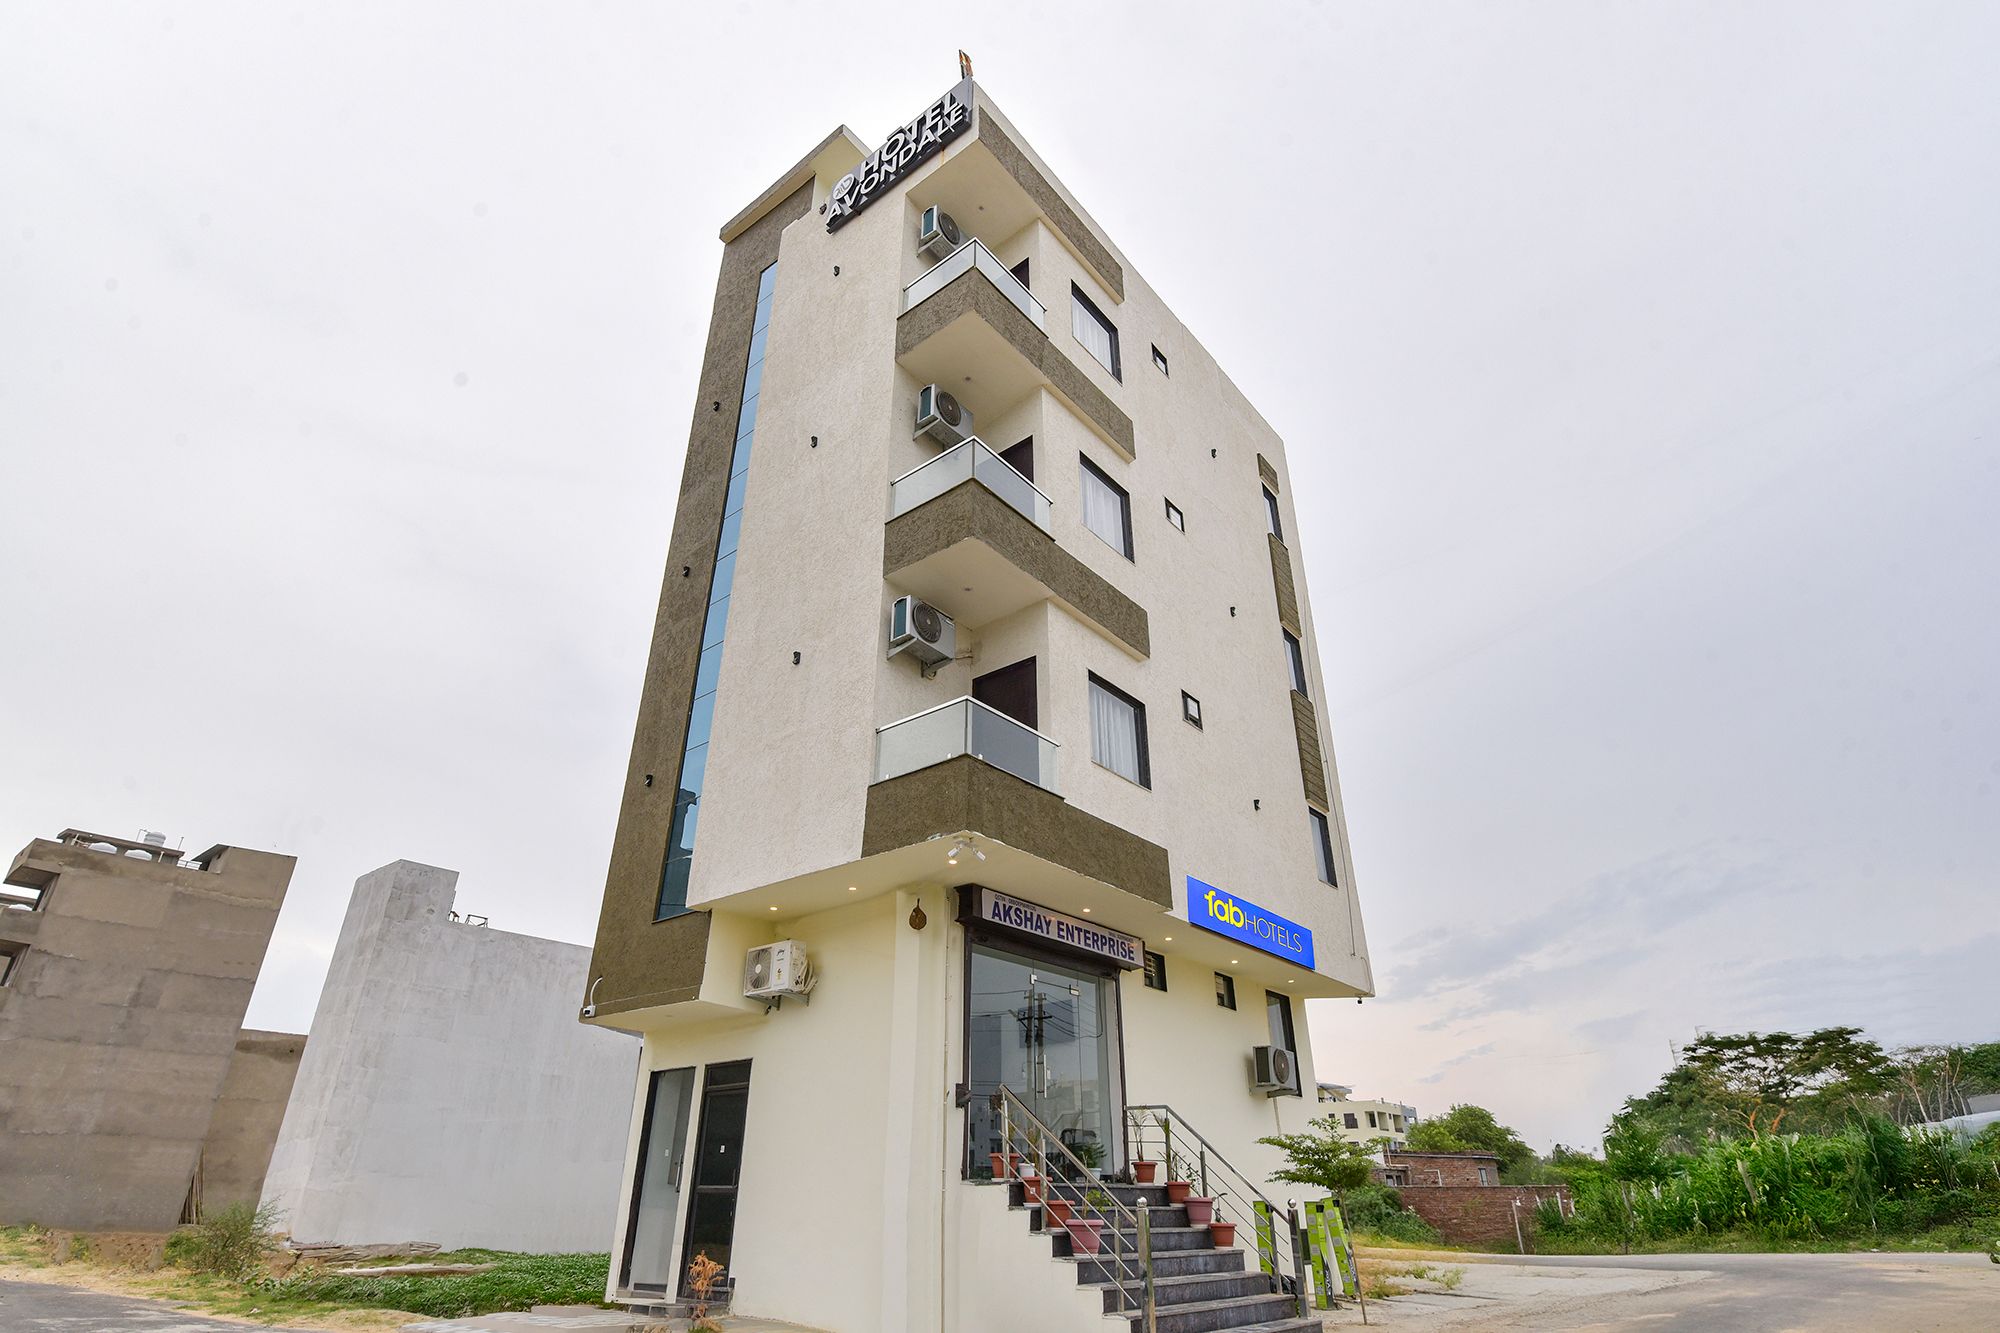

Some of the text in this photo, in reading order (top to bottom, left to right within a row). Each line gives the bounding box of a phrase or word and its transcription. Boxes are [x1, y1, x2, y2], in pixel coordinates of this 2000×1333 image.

[826, 102, 966, 225] AVONDALE
[860, 92, 958, 182] HOTEL
[992, 900, 1052, 935] AKSHAY
[1056, 920, 1136, 961] ENTERPRISE
